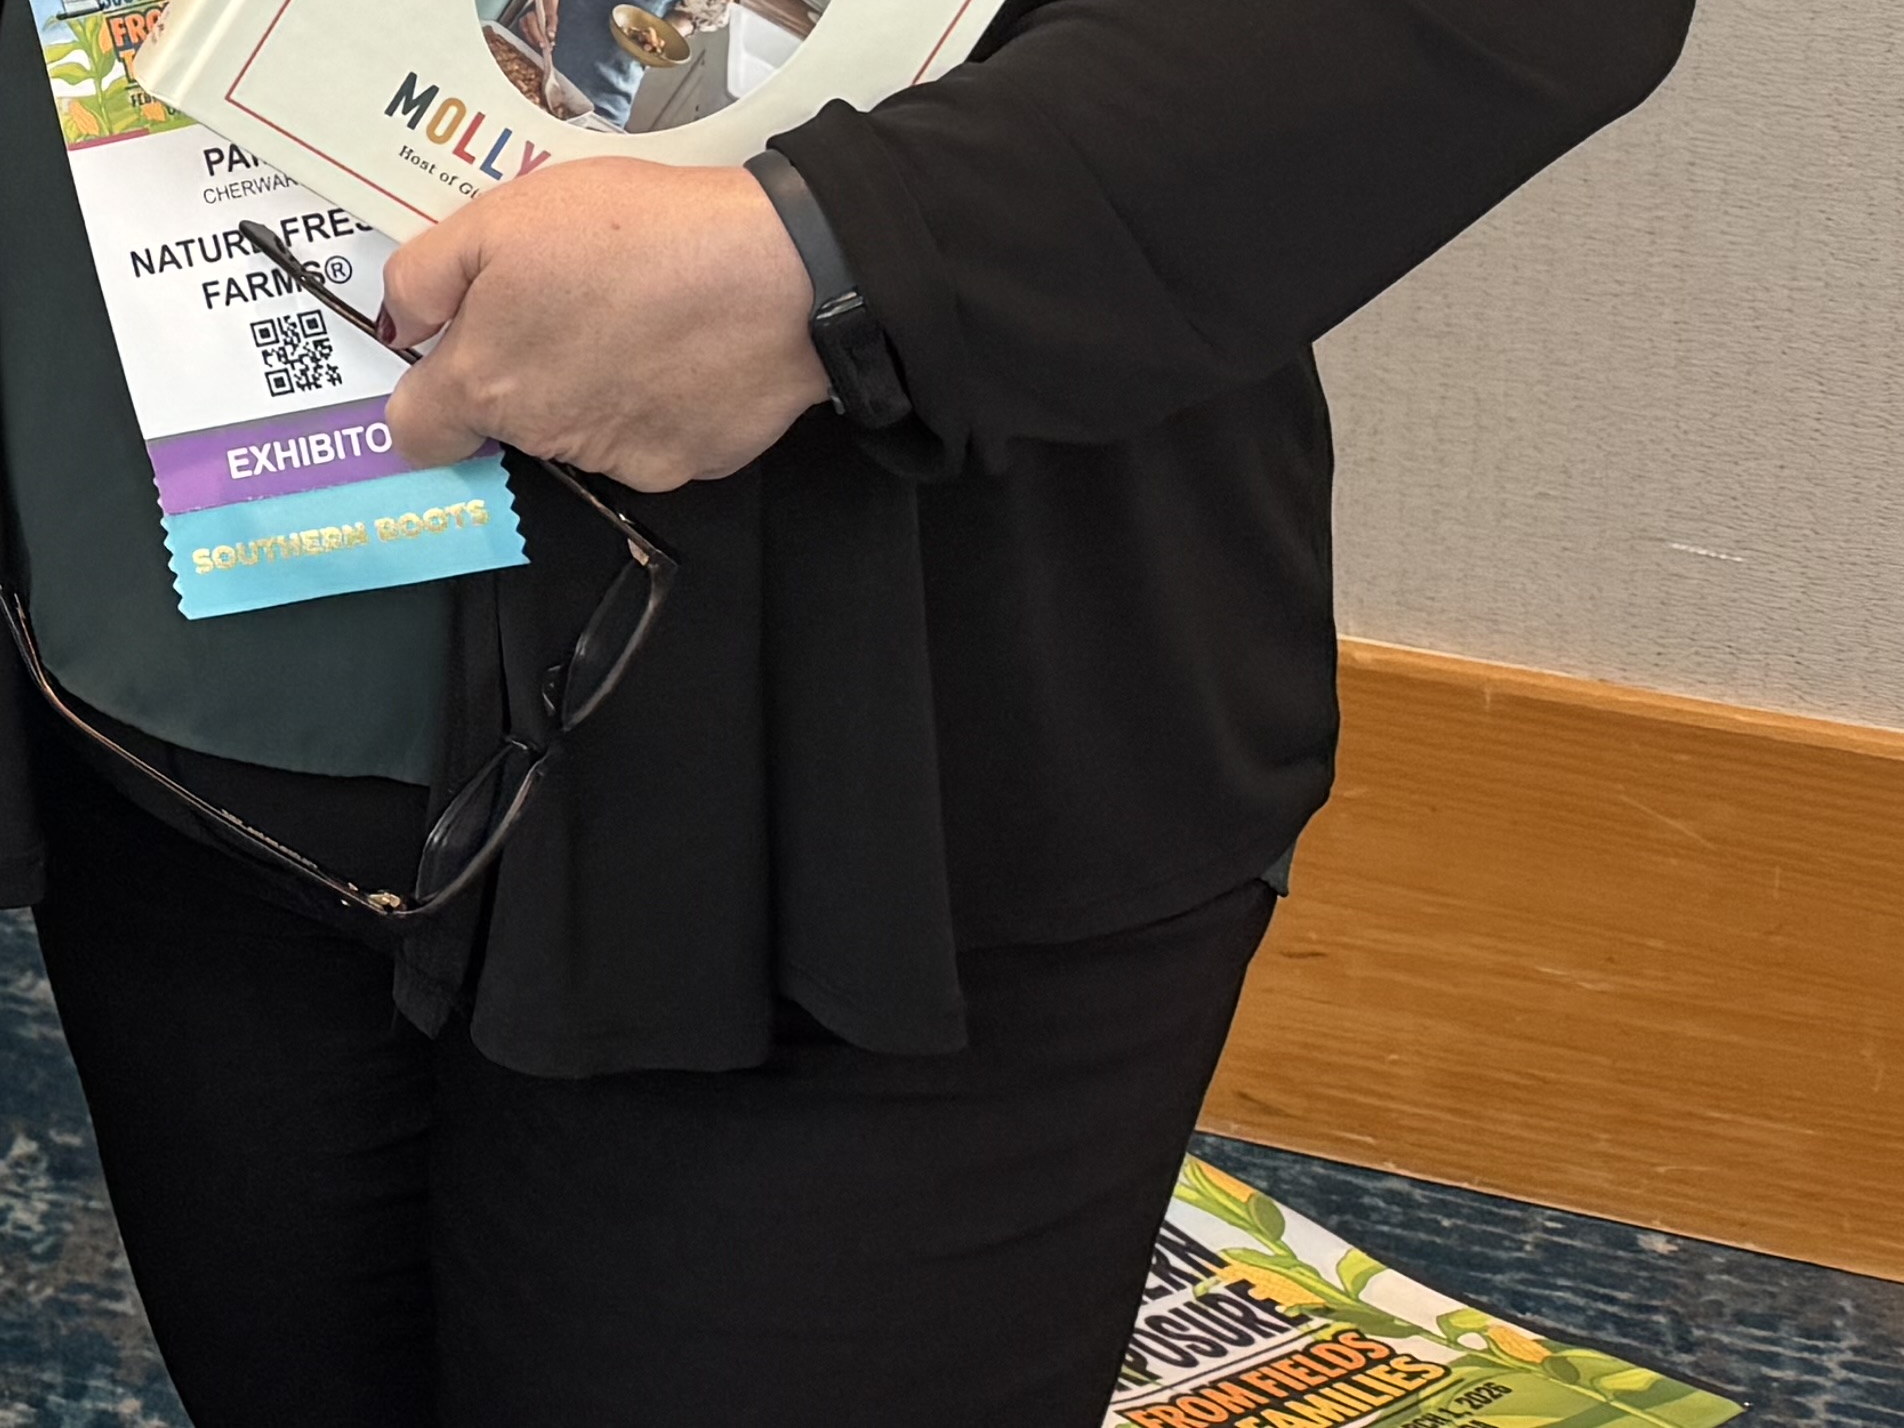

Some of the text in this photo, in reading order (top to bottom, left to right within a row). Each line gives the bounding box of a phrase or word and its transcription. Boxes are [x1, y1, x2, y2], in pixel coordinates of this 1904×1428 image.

[383, 71, 552, 181] MOLLY
[398, 144, 459, 186] Host of
[130, 220, 263, 279] NATUR
[226, 421, 394, 481] EXHIBITO
[192, 499, 490, 575] SOUTHERN ROOTS
[1234, 1355, 1446, 1428] FAMILIES
[1242, 1332, 1390, 1399] FIELDS
[1454, 1381, 1513, 1410] 2026
